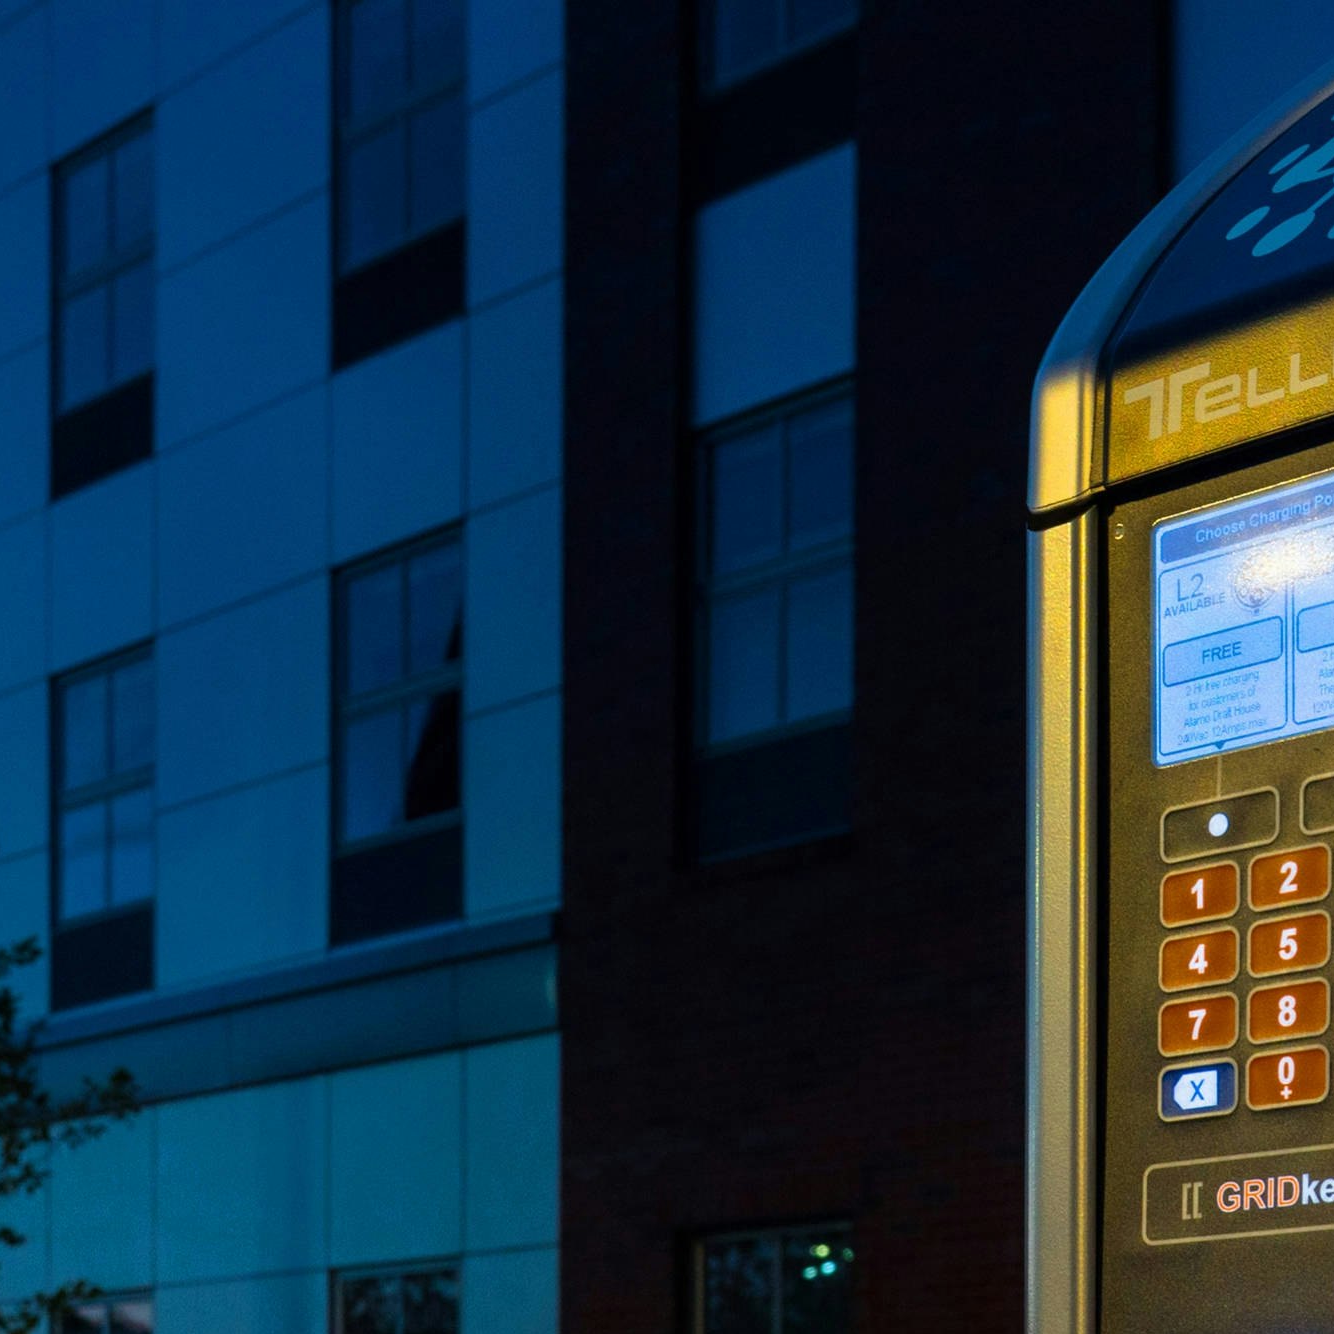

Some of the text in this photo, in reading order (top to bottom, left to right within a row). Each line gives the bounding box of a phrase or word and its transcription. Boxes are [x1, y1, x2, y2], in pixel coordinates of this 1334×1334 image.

[1195, 520, 1246, 544] Choose
[1249, 500, 1312, 527] Charging
[1163, 592, 1226, 619] AVAILABLE
[1176, 573, 1204, 602] L2
[1201, 640, 1242, 664] FREE
[1190, 877, 1205, 910] 1
[1279, 862, 1299, 894] 2
[1188, 943, 1209, 975] 4
[1278, 928, 1298, 960] 5
[1188, 1009, 1207, 1041] 7
[1277, 995, 1297, 1027] 8
[1277, 1055, 1295, 1085] 0
